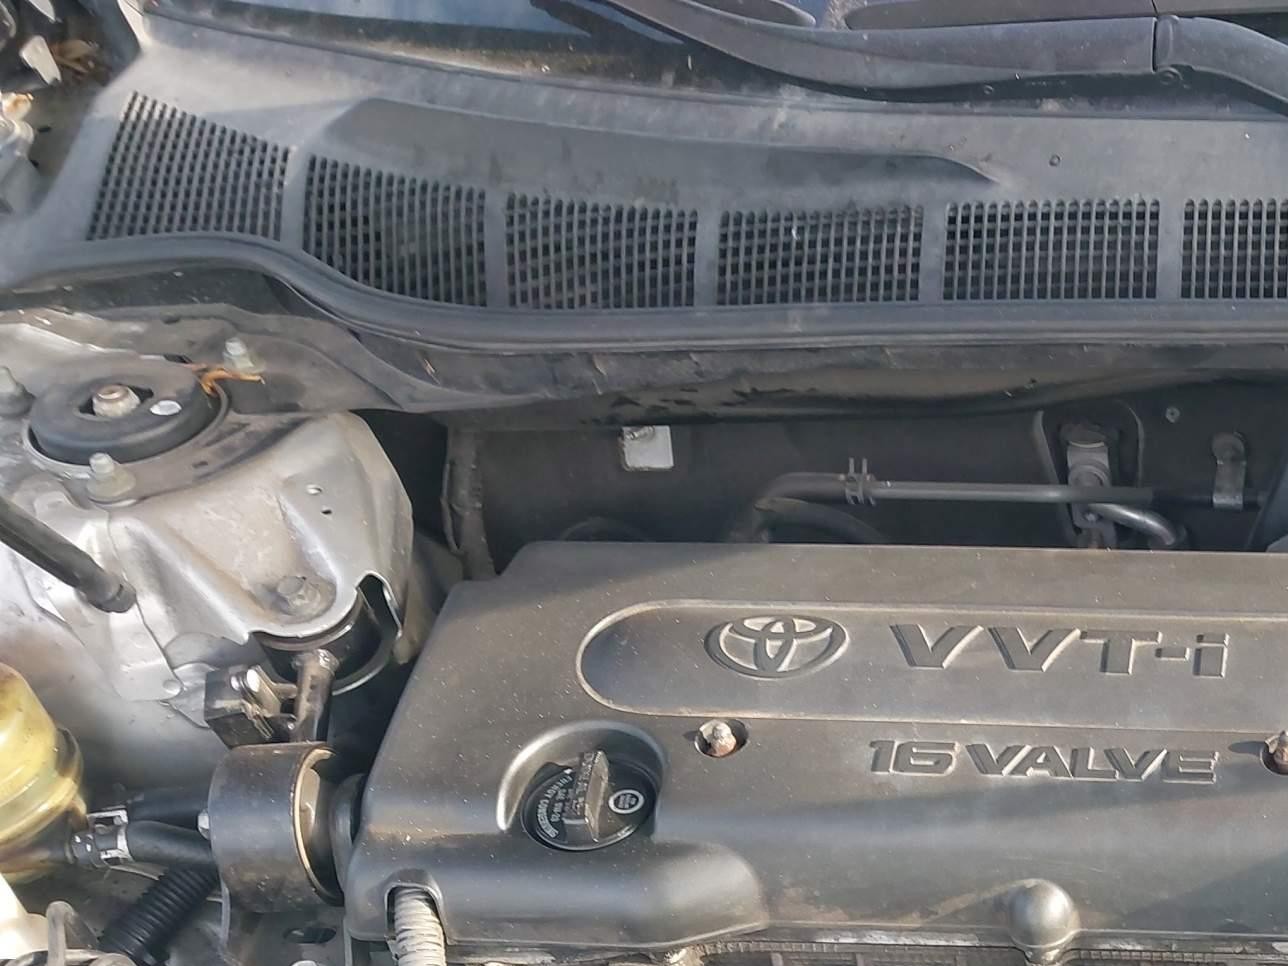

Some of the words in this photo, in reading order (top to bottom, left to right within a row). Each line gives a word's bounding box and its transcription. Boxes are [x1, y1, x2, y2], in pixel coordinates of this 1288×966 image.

[889, 623, 1229, 678] VVT-i
[869, 739, 959, 776] 16
[965, 742, 1220, 784] VALVE
